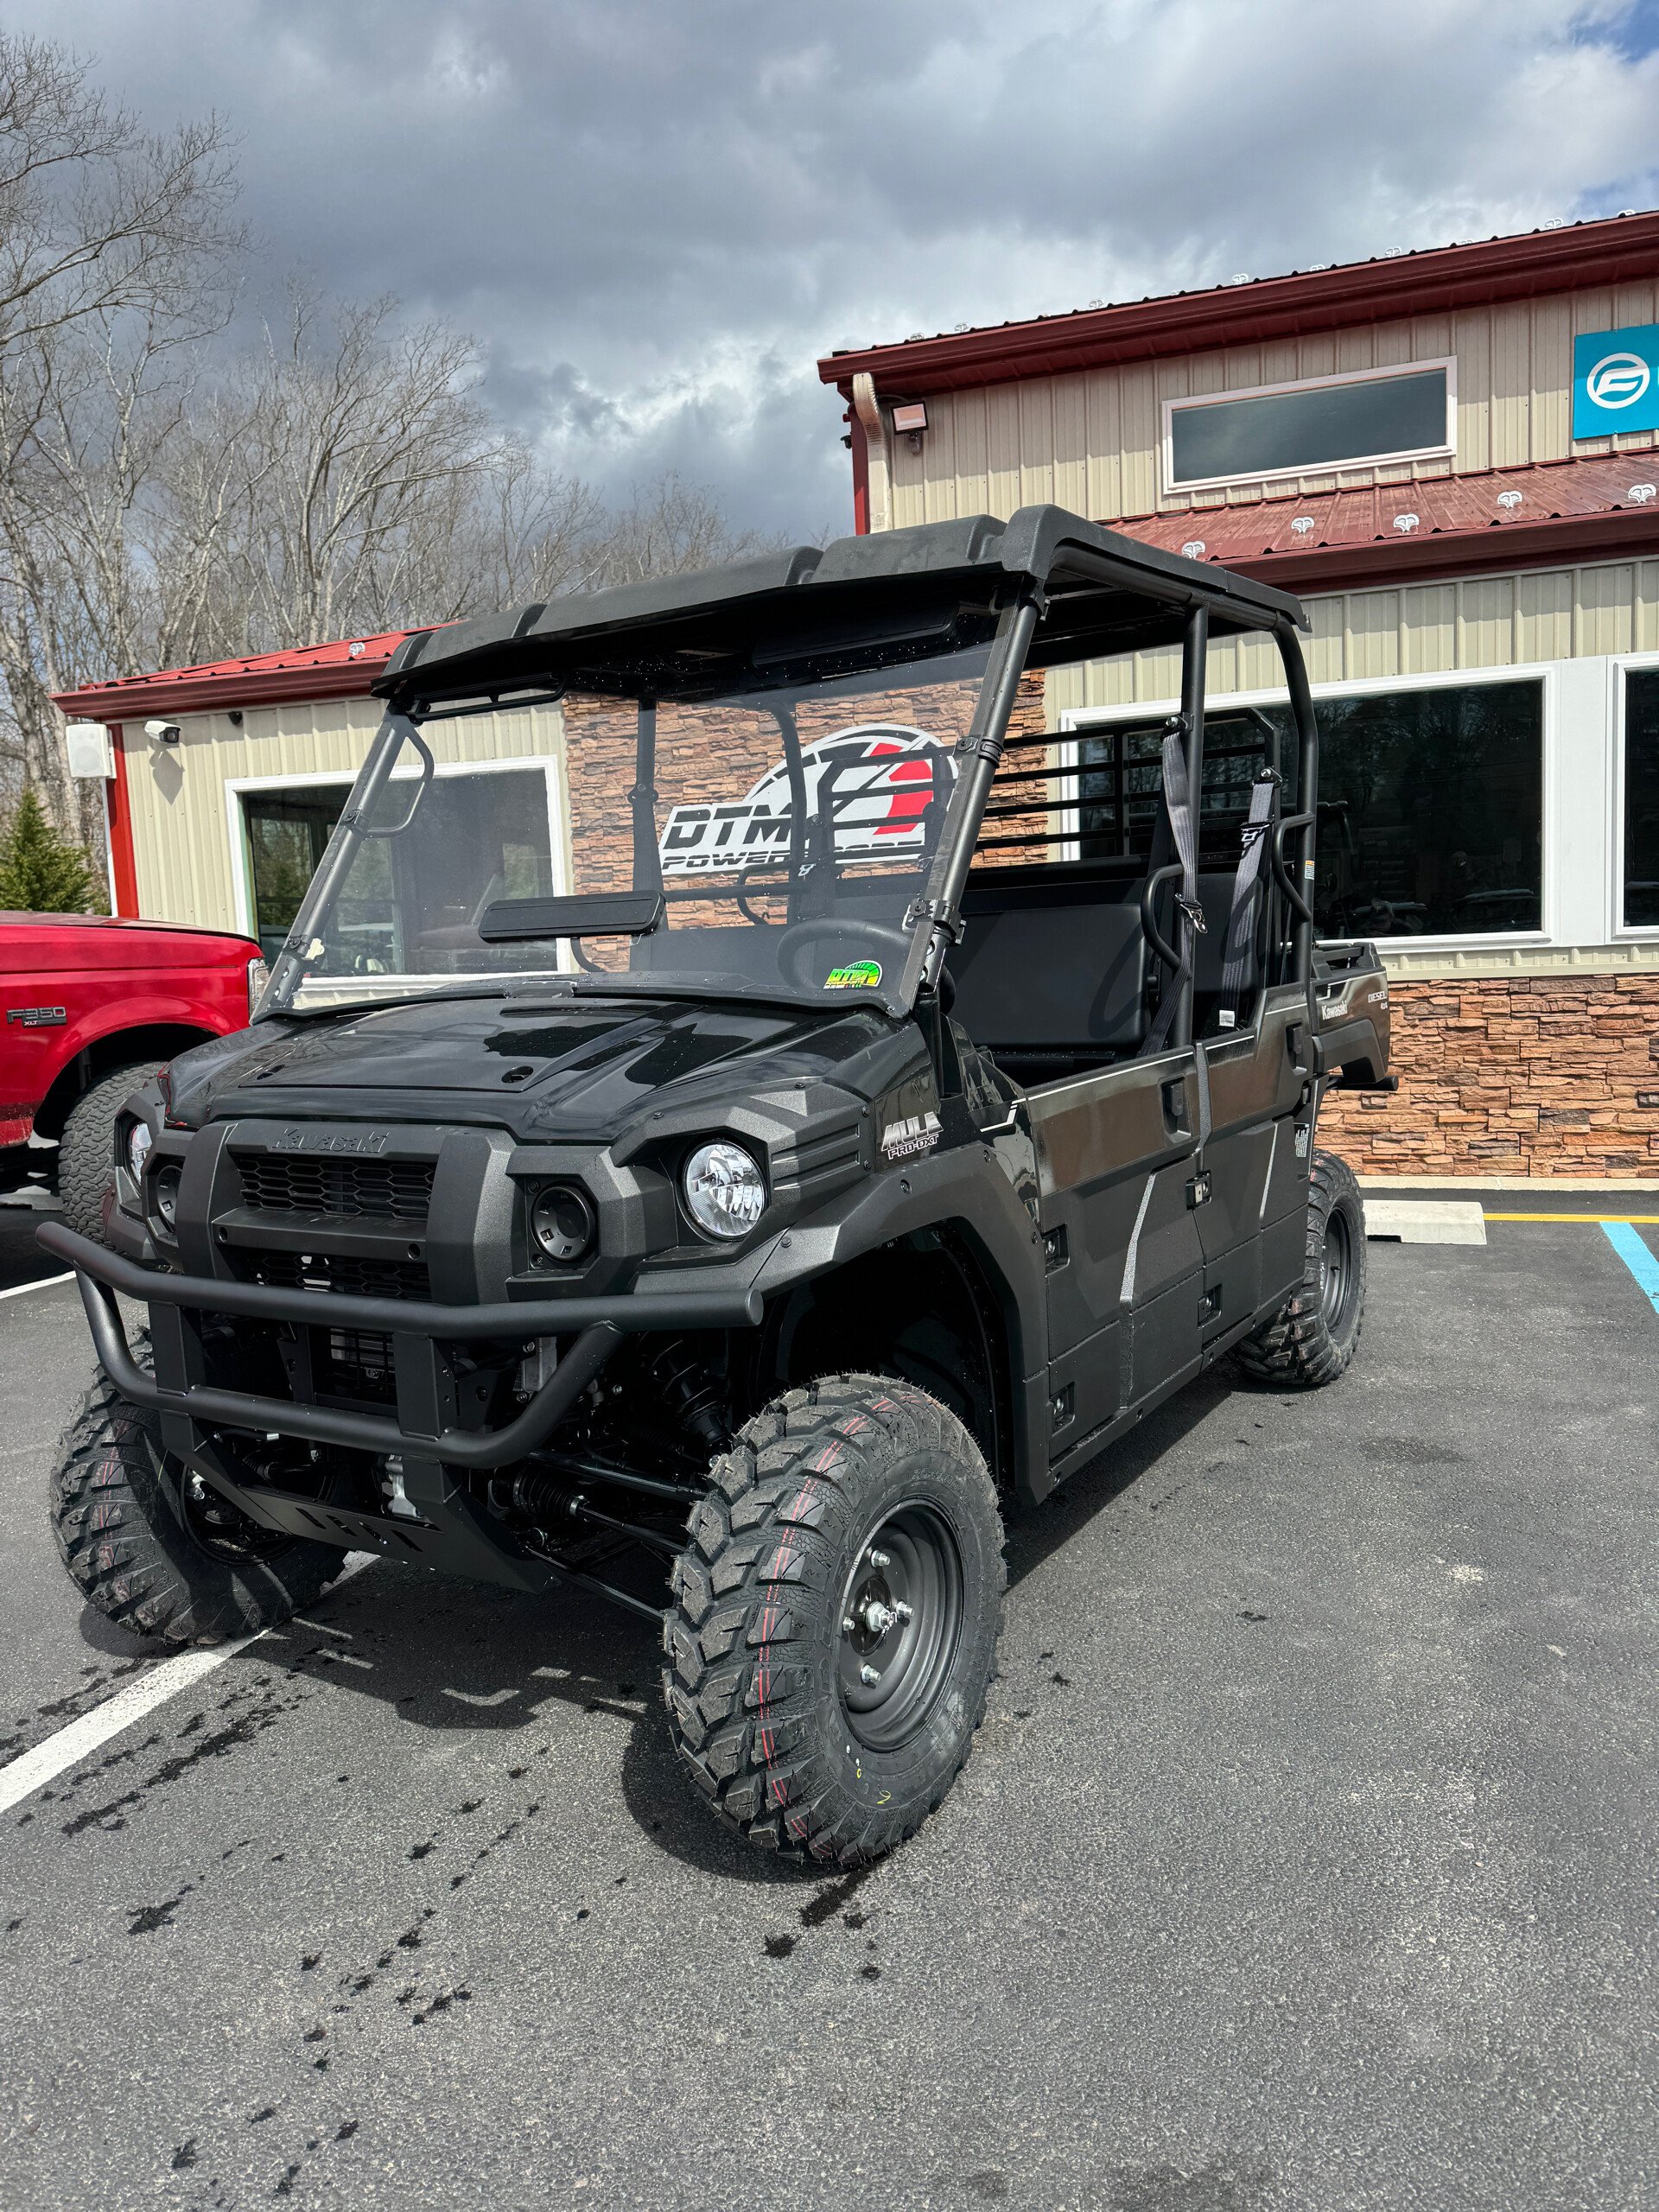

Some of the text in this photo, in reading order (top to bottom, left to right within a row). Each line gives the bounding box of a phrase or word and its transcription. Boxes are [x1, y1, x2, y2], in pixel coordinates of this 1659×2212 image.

[663, 803, 792, 849] DTM
[828, 969, 870, 982] DTM
[1321, 1001, 1348, 1020] Kawasaki
[271, 1127, 390, 1154] Kawasaki
[880, 1111, 944, 1152] MULE
[888, 1133, 939, 1160] PRO-DXT
